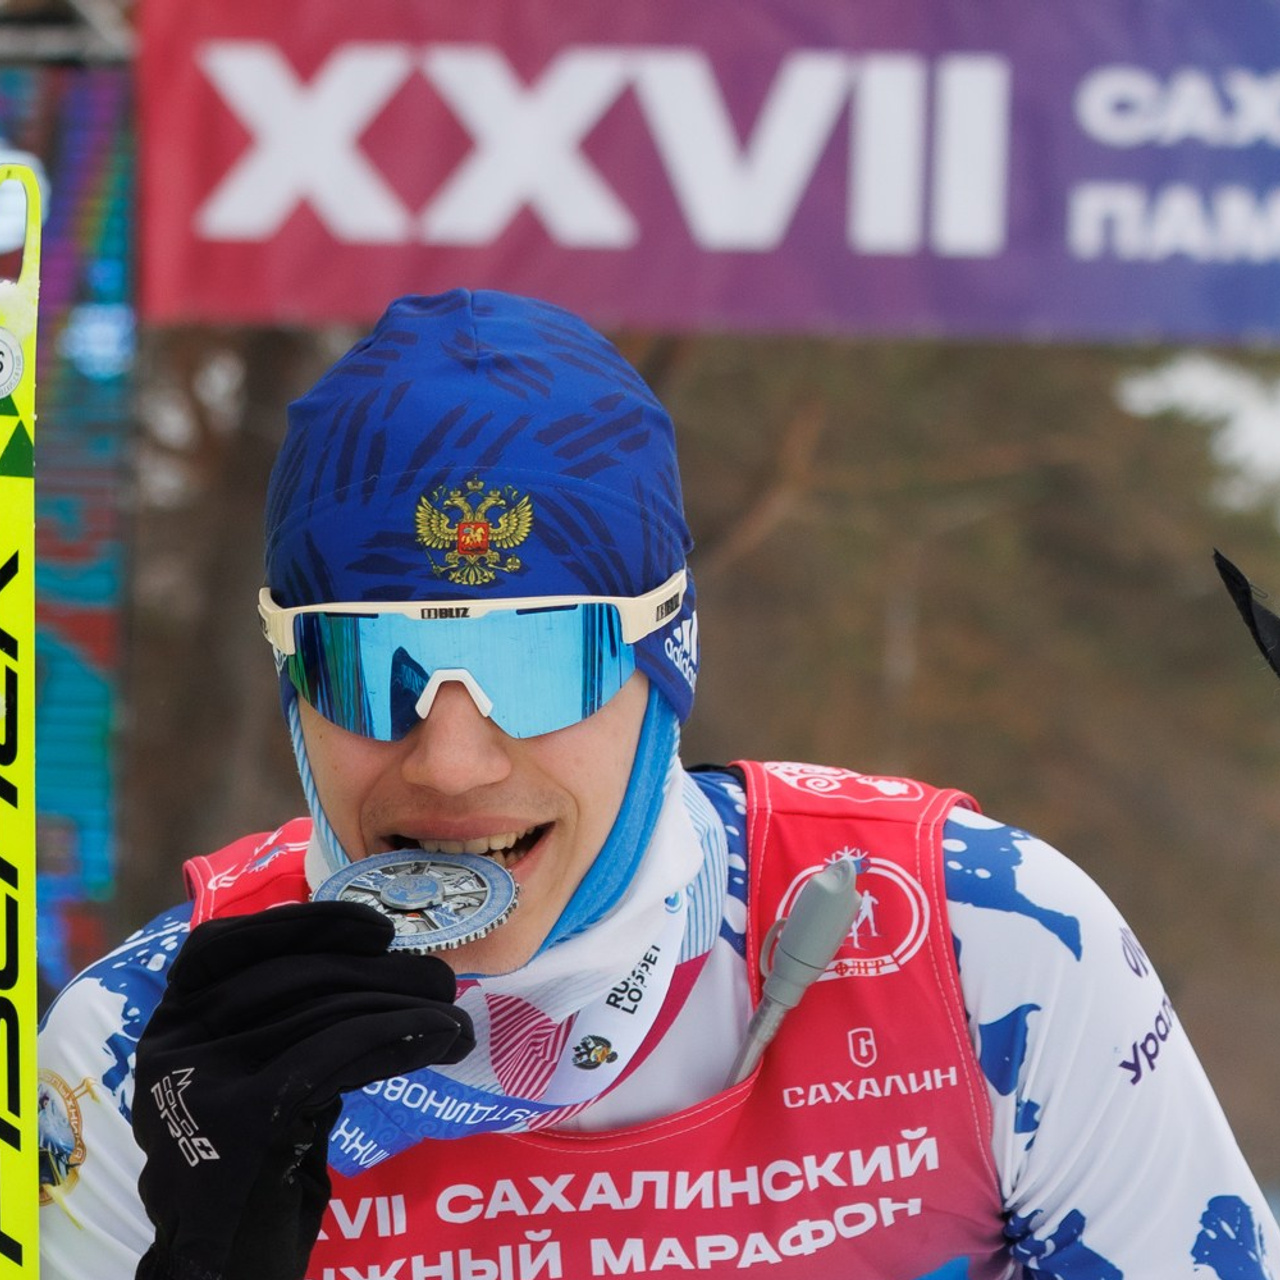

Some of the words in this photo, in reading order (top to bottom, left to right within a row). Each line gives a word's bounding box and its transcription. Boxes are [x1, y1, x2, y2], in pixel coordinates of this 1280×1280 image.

[194, 42, 1009, 257] XXVII
[783, 1066, 958, 1108] САХАЛИН
[317, 1194, 407, 1240] VII
[436, 1126, 939, 1224] САХАЛИНСКИЙ
[590, 1197, 922, 1278] МАРАФОН
